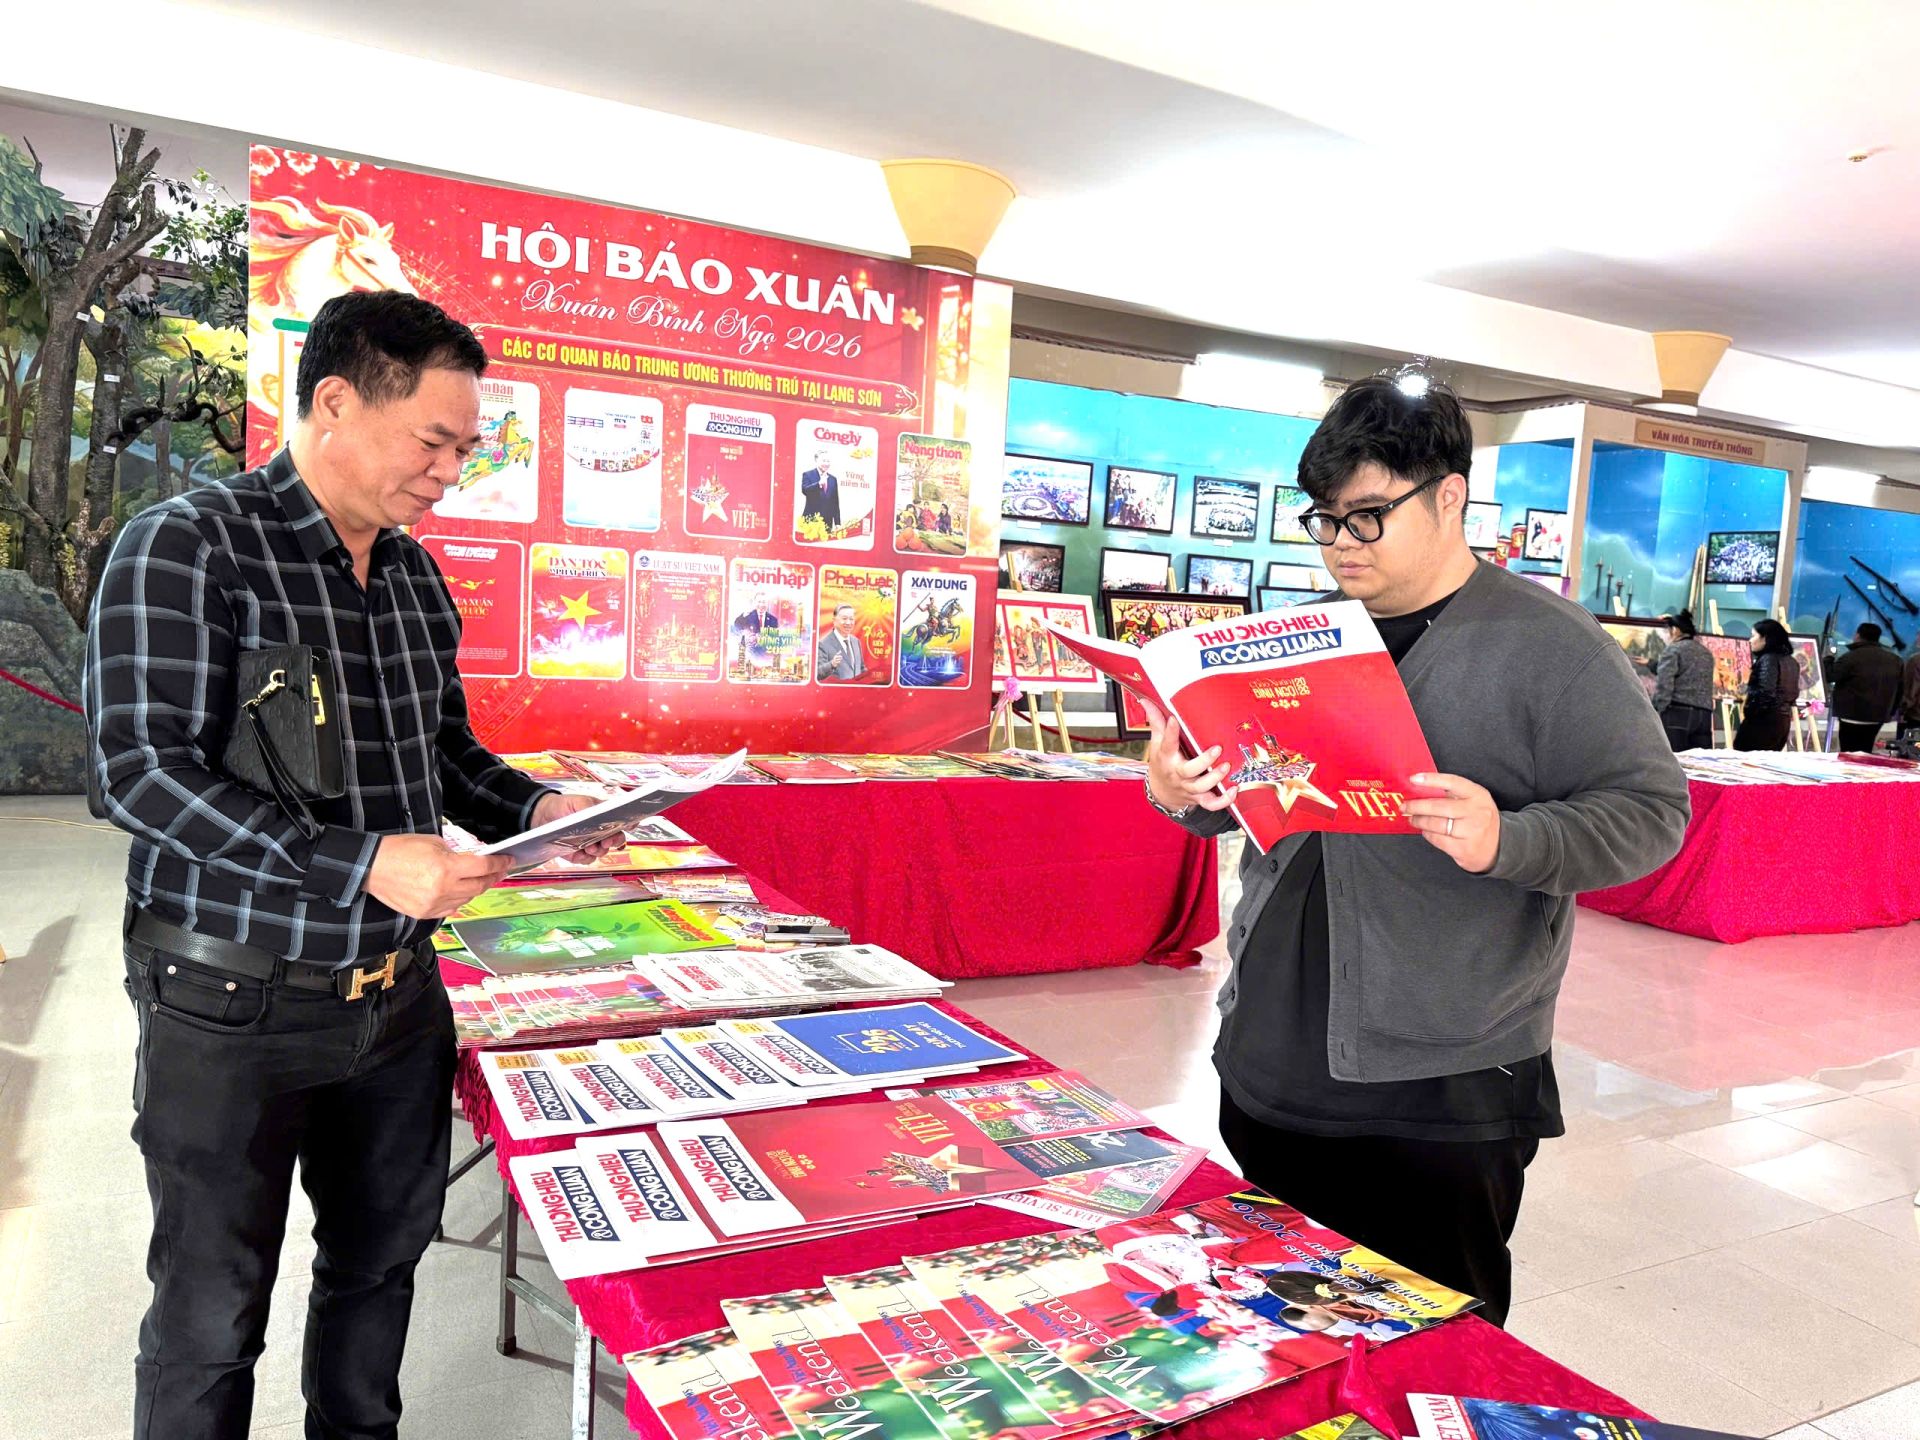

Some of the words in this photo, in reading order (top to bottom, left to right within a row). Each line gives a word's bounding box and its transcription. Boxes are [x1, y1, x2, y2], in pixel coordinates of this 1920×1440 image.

[481, 221, 590, 276] HỘI
[605, 240, 733, 296] BÁO
[744, 266, 895, 326] XUÂN
[520, 279, 619, 321] Xuân
[626, 295, 706, 335] Bính
[714, 308, 777, 355] Ngọ
[784, 326, 862, 358] 2026
[502, 336, 532, 359] CÁC
[537, 343, 557, 361] CƠ
[561, 345, 598, 367] QUAN
[602, 350, 631, 371] BÁO
[634, 355, 679, 377] TRUNG
[683, 361, 719, 384] ƯƠNG
[722, 367, 772, 392] THƯỜNG
[775, 375, 799, 395] TRÚ
[802, 381, 820, 401] TẠI
[824, 384, 854, 406] LẠNG
[858, 390, 882, 407] SƠN
[1651, 429, 1669, 440] VĂN
[1671, 433, 1689, 445] HÓA
[1338, 788, 1412, 821] VIỆT
[1229, 1202, 1304, 1241] 2026
[1281, 1244, 1364, 1292] Christmas
[1305, 1240, 1341, 1263] Year
[1343, 1262, 1382, 1285] New
[1364, 1290, 1423, 1317] Merry
[1382, 1281, 1443, 1311] Happy
[876, 1298, 993, 1414] Weekend
[1015, 1286, 1157, 1391] Weekend
[771, 1327, 884, 1438] Weekend
[1426, 1395, 1456, 1427] NAM
